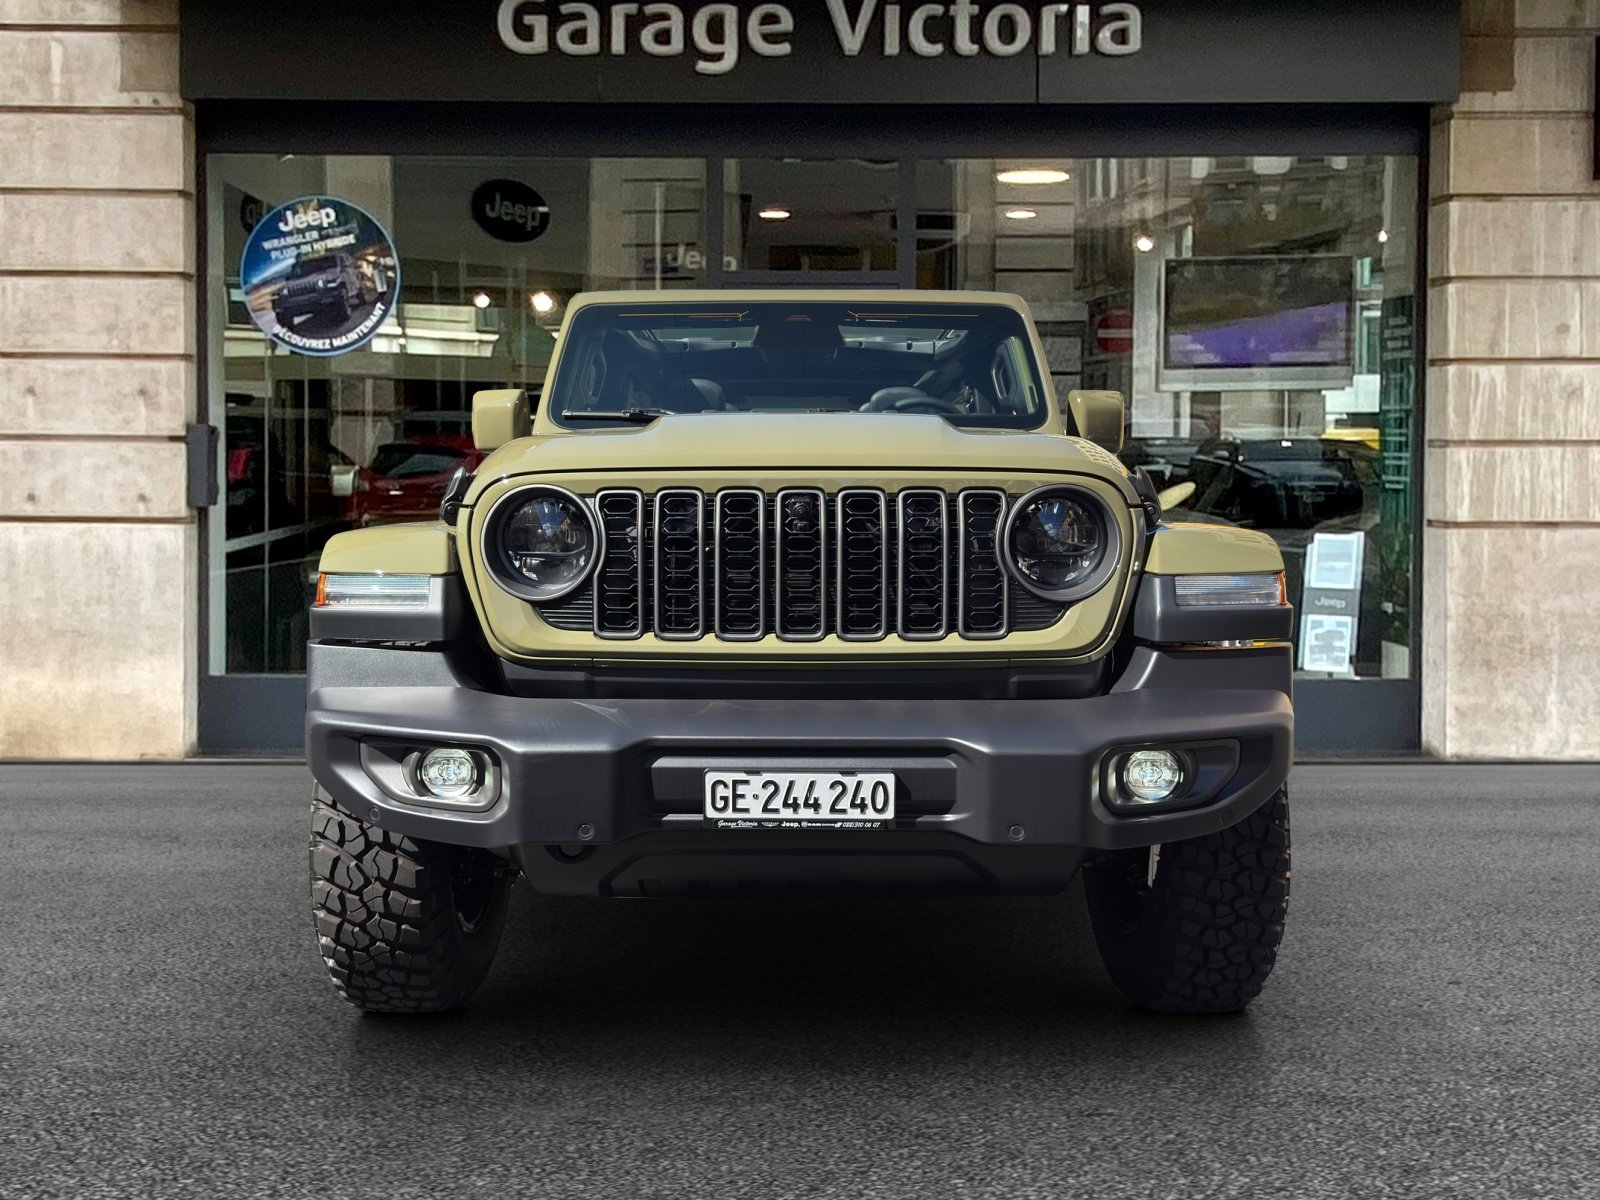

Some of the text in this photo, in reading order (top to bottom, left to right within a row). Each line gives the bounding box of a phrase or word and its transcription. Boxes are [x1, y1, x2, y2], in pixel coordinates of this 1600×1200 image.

[497, 0, 1143, 75] Garage Victoria
[278, 207, 337, 232] Jeep
[485, 191, 541, 232] Jeep
[262, 230, 320, 250] WRANGLER
[332, 301, 386, 348] MAINTENANT
[828, 779, 889, 814] 240
